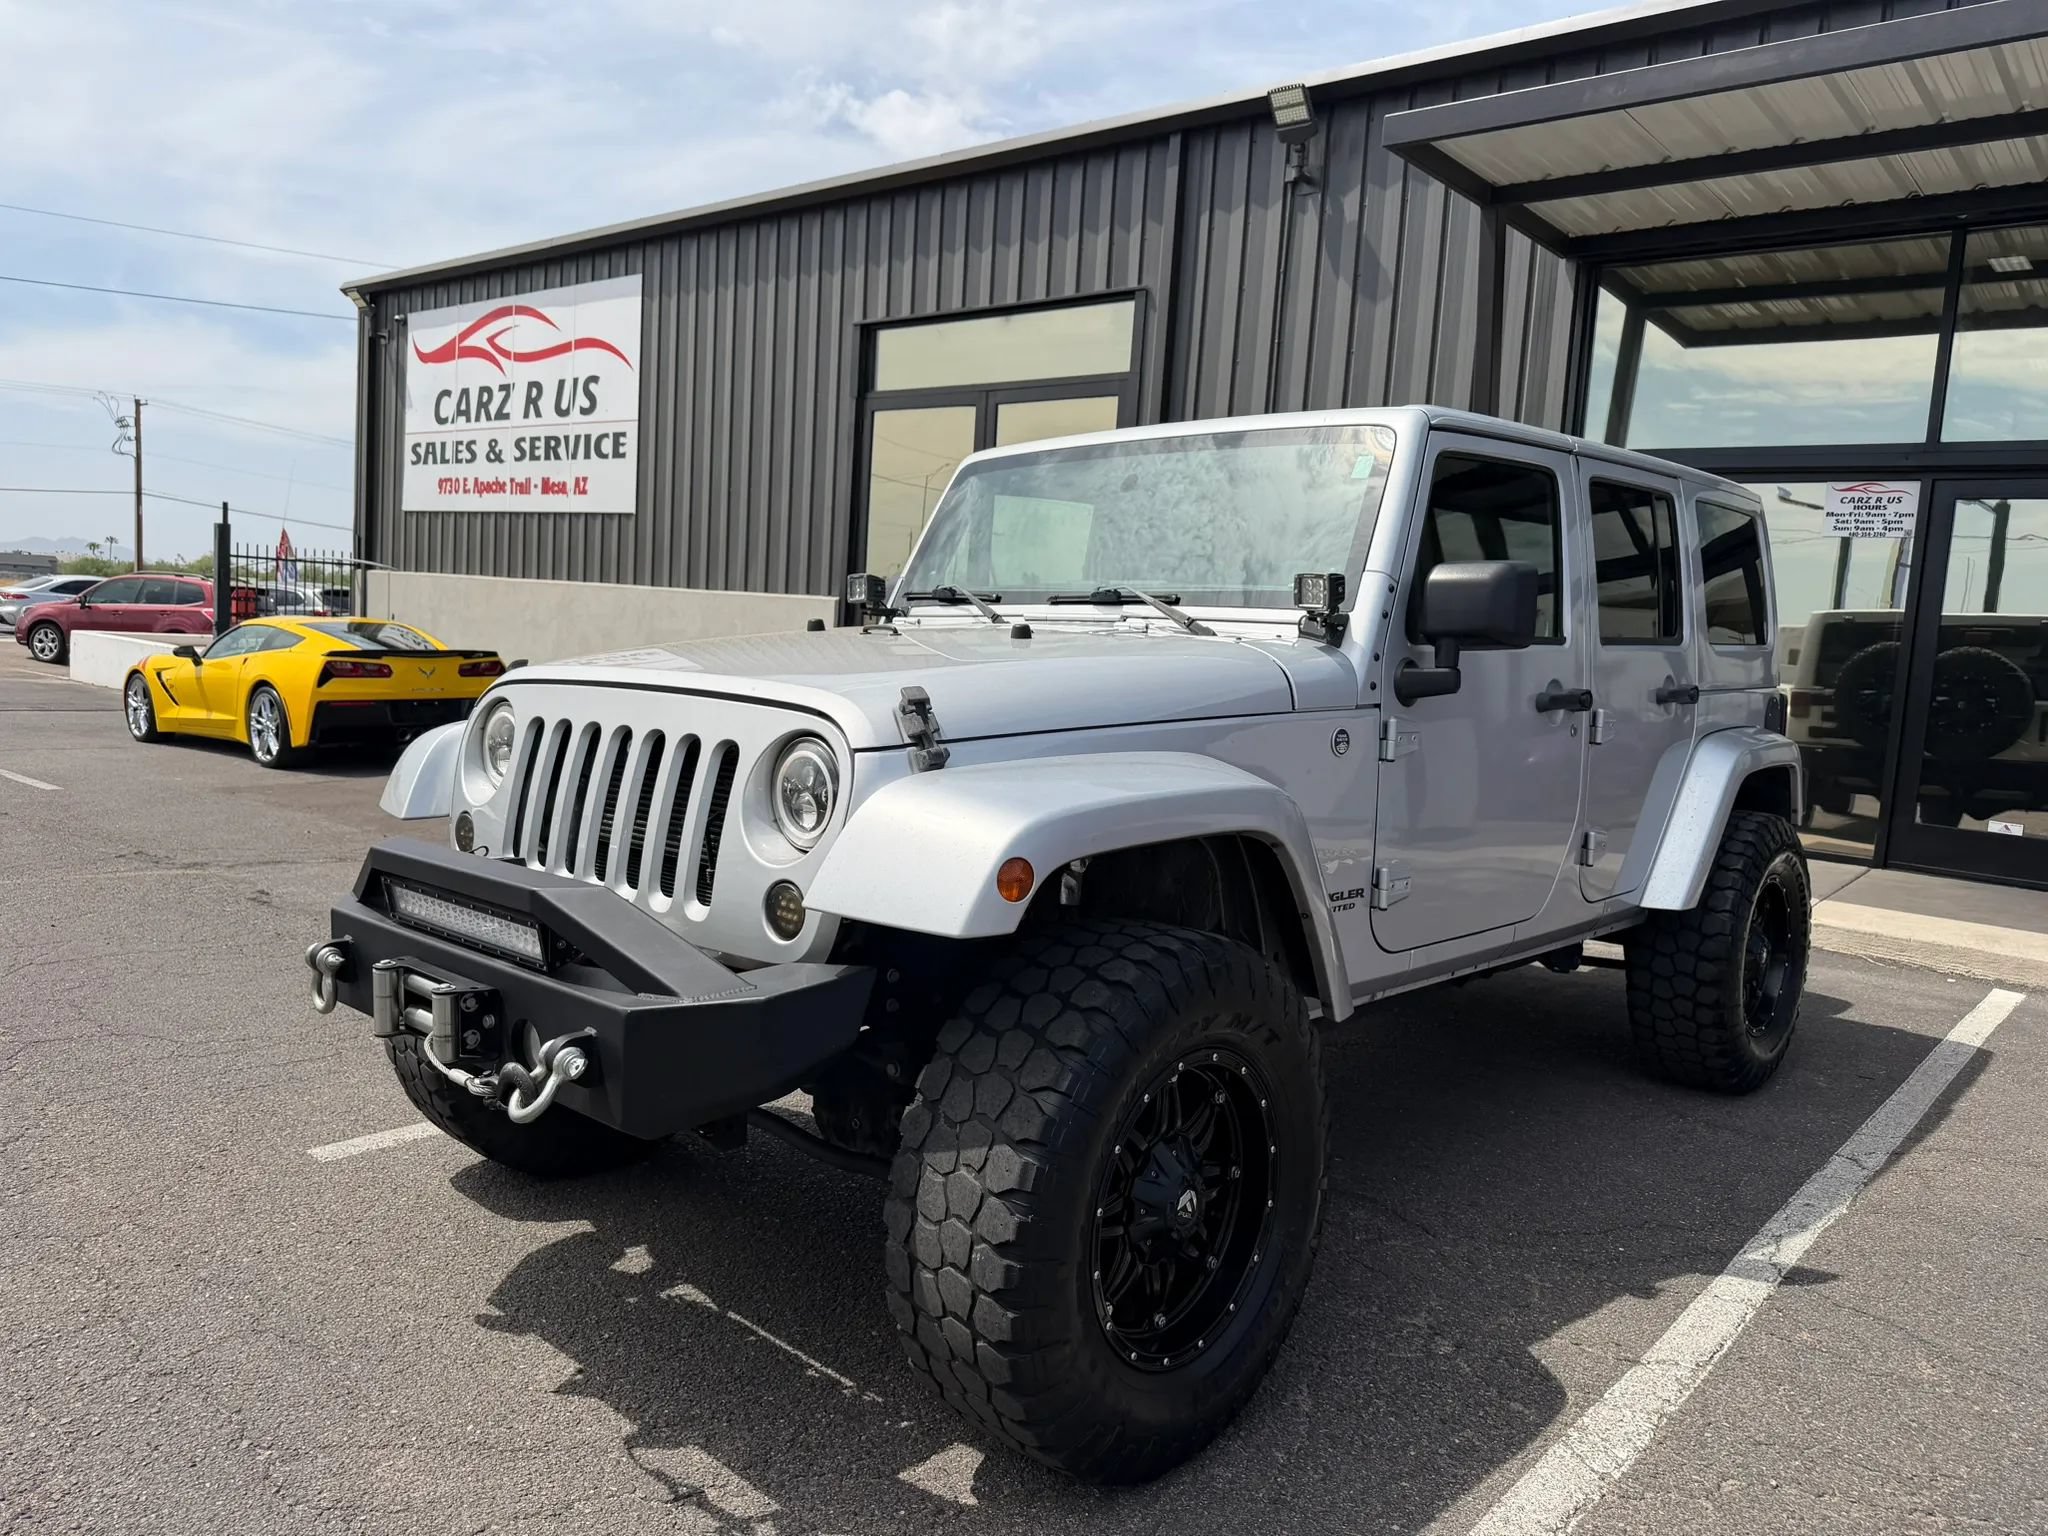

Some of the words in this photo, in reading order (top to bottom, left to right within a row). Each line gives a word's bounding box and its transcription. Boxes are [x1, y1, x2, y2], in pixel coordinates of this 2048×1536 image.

[523, 380, 544, 419] R
[554, 375, 600, 417] US
[410, 440, 477, 466] SALES
[485, 438, 505, 463] &
[513, 432, 627, 462] SERVICE
[437, 477, 461, 495] 9730
[463, 477, 471, 494] E.
[473, 476, 507, 498] Apache
[510, 477, 531, 495] Trail
[573, 476, 588, 495] AZ
[1840, 496, 1872, 504] CARZ
[1875, 496, 1883, 504] R
[1887, 496, 1903, 504] US
[1882, 518, 1903, 526] 5pm
[1882, 525, 1904, 533] 4pm
